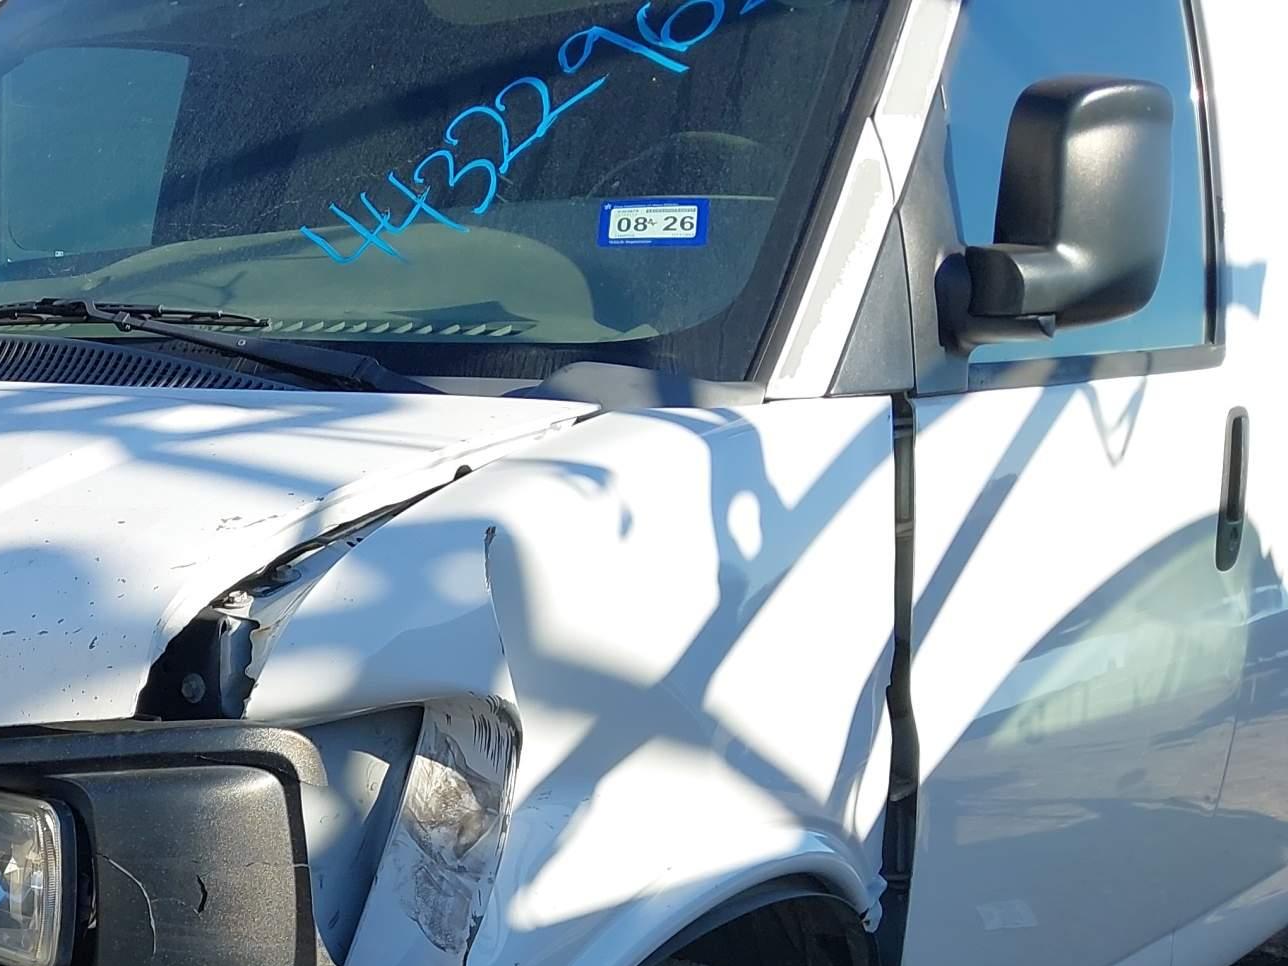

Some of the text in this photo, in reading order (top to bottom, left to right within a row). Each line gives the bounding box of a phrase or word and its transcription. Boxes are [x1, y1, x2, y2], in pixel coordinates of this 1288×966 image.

[299, 0, 766, 266] 4432296
[617, 215, 695, 232] 08 26
